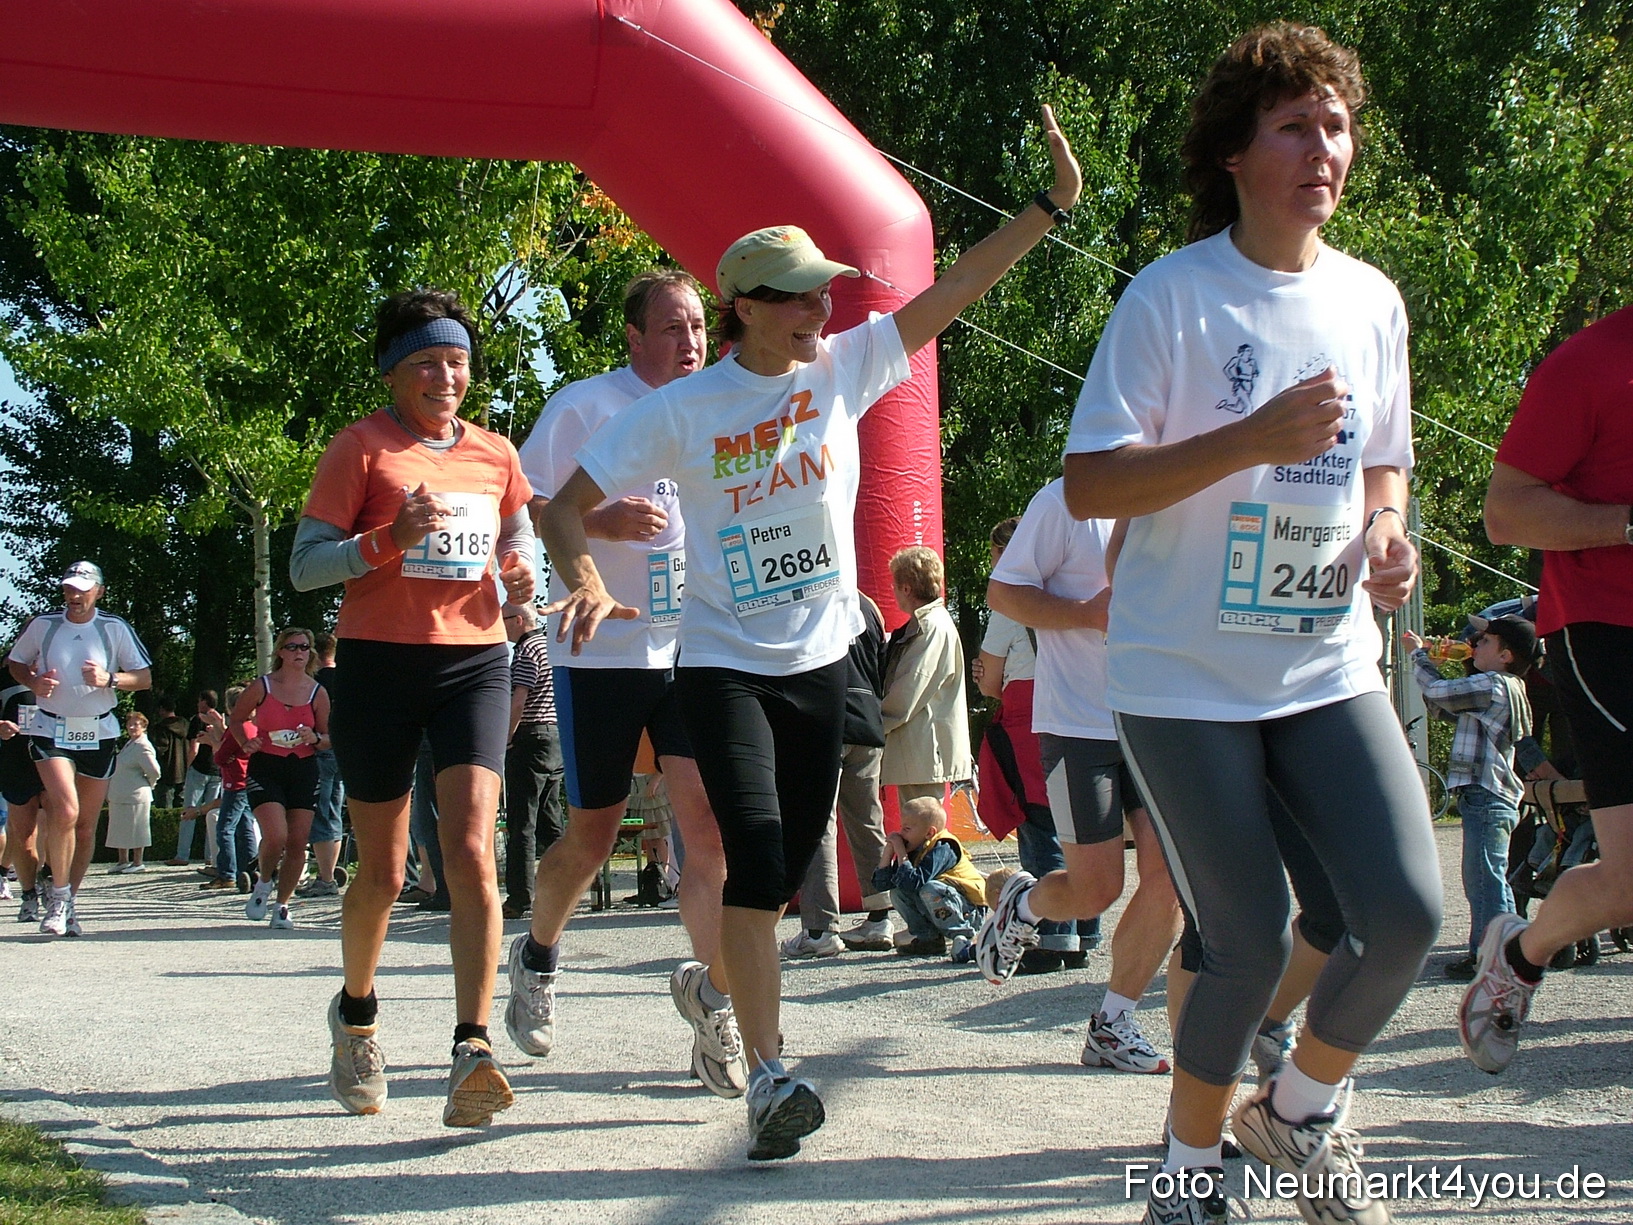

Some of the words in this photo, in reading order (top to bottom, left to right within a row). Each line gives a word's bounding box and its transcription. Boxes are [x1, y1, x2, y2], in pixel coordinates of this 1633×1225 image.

[1274, 465, 1351, 487] Stadtlauf
[913, 500, 923, 527] 1929
[437, 532, 490, 556] 3185
[750, 525, 791, 545] Petra
[730, 560, 740, 574] C
[761, 543, 832, 584] 2684
[1232, 552, 1242, 570] D
[654, 581, 660, 593] D
[1270, 563, 1348, 599] 2420
[737, 594, 779, 612] BOCK
[1221, 610, 1280, 627] BOCK
[67, 731, 95, 741] 3689
